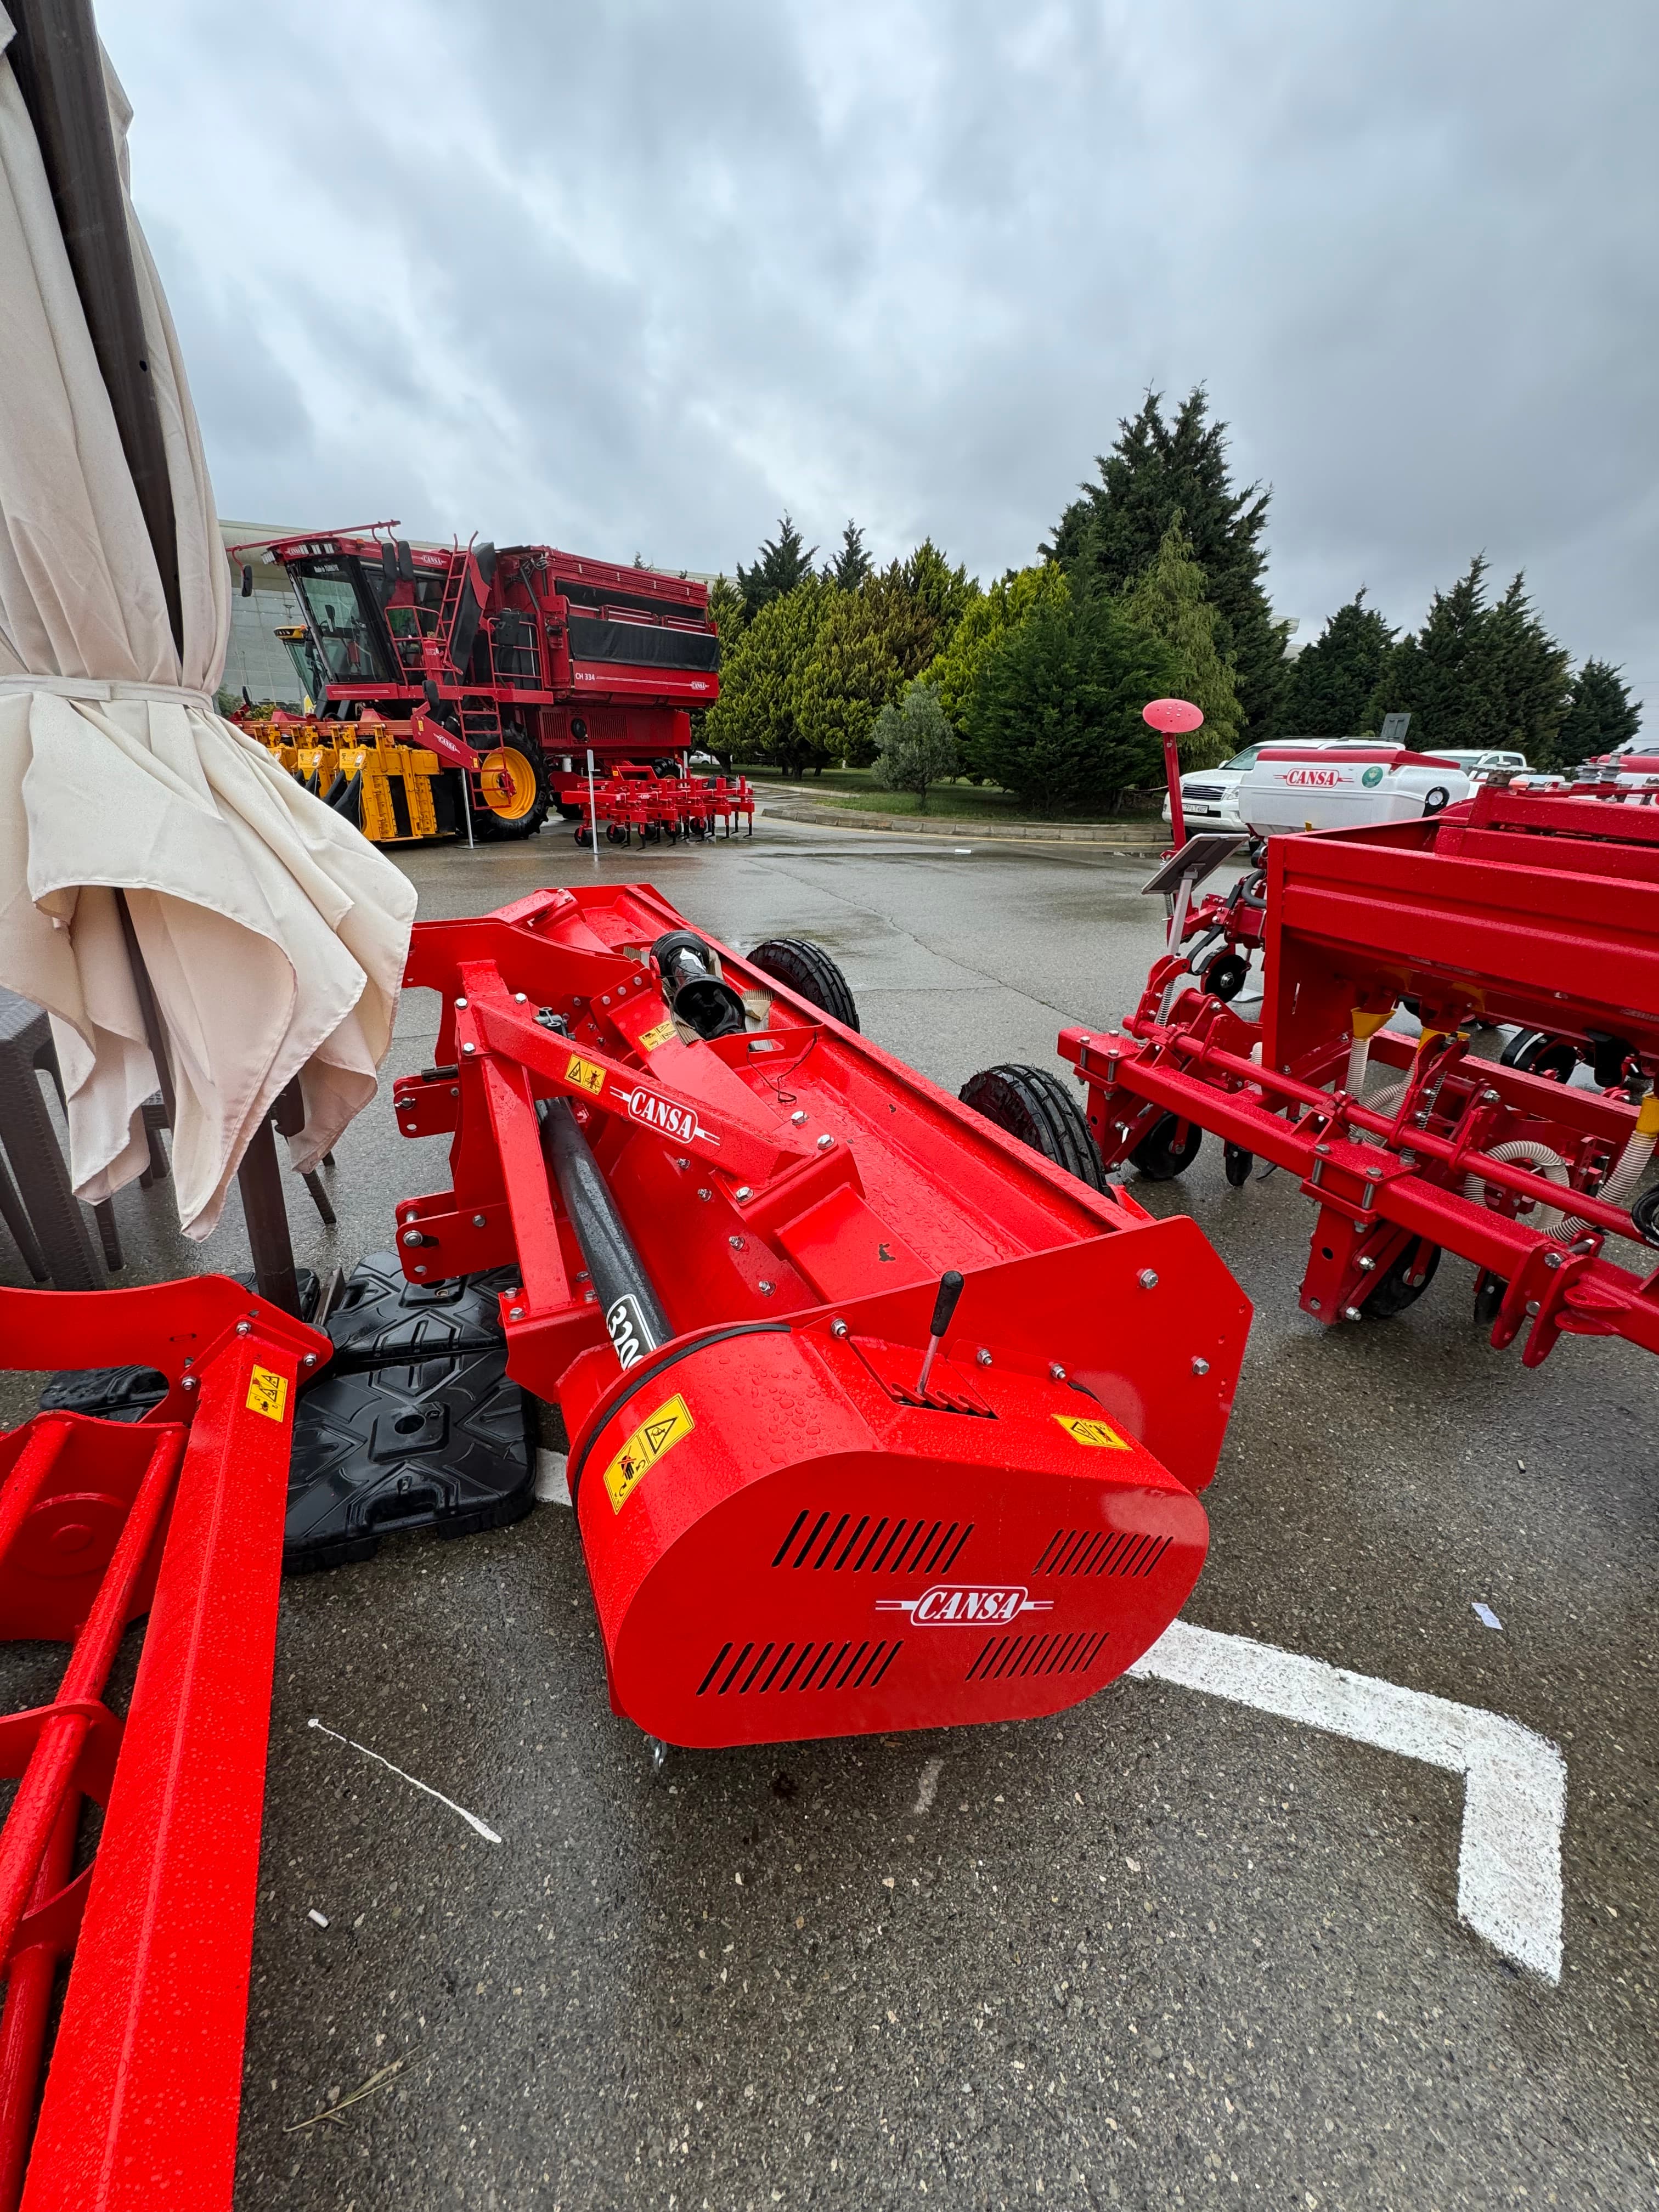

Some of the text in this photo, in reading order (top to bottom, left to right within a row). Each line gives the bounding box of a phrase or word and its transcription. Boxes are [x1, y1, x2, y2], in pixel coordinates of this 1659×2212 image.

[424, 556, 441, 564] CANSA
[439, 736, 455, 751] CANSA
[1289, 771, 1334, 785] CANSA
[632, 1092, 692, 1139] CANSA
[918, 1592, 1019, 1619] CANSA
